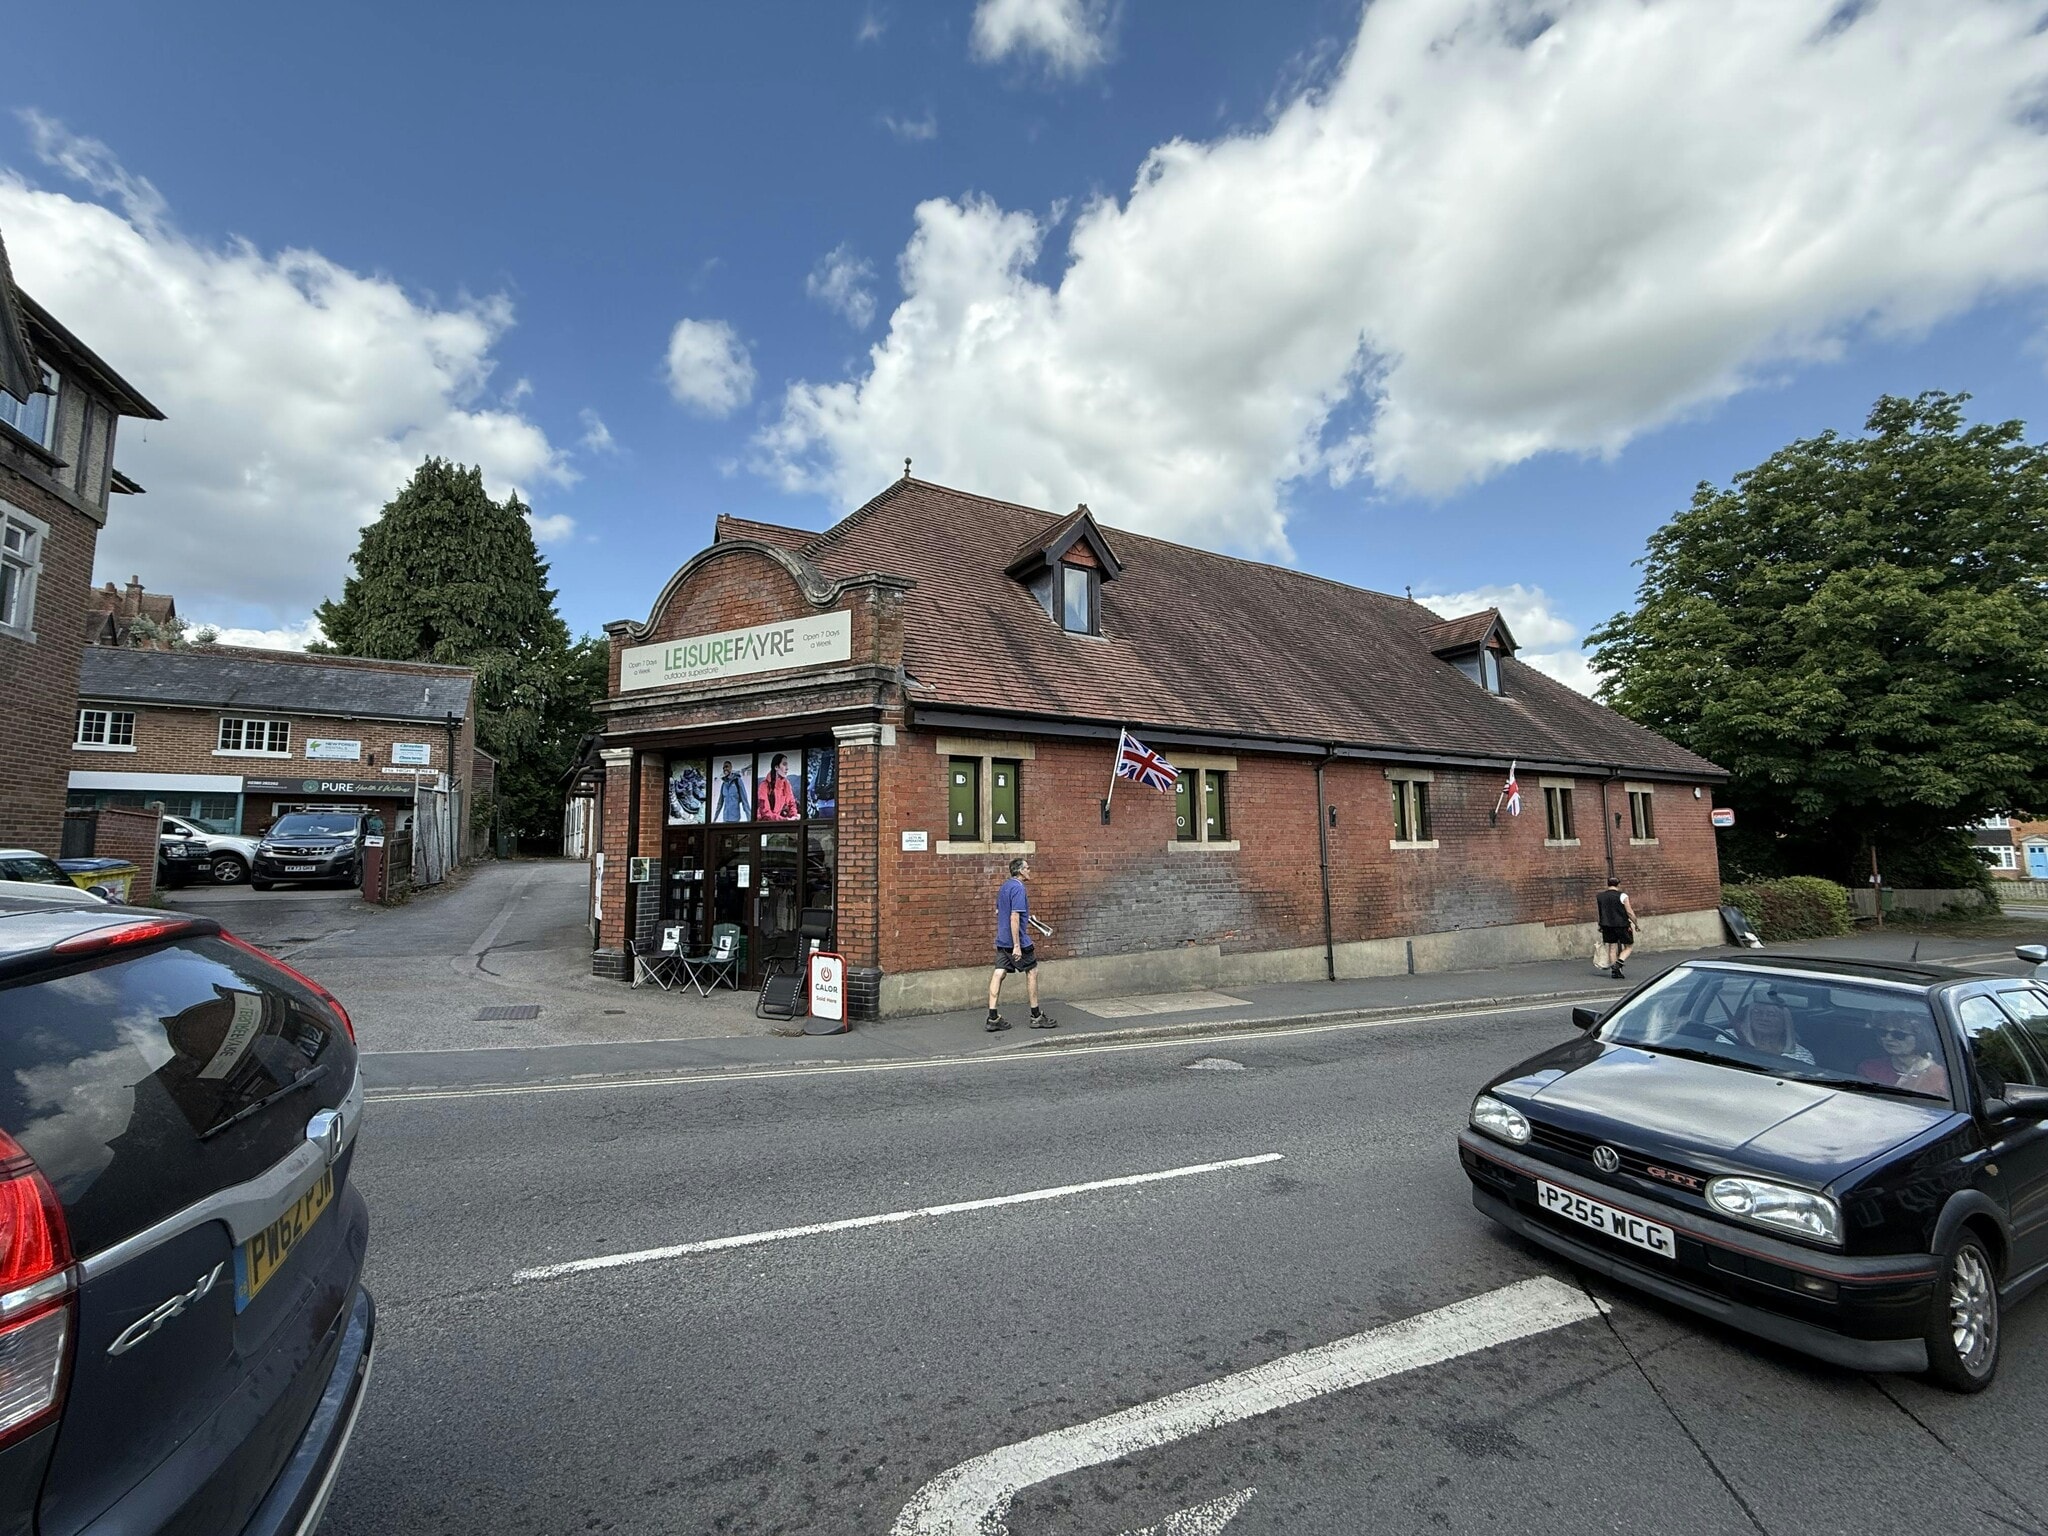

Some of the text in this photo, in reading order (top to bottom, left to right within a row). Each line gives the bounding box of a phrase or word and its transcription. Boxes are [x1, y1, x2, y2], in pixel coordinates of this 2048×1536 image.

[803, 633, 820, 642] Open
[825, 629, 840, 639] Days
[664, 628, 795, 672] LEISUREFAYRE
[816, 640, 832, 648] Week
[629, 661, 642, 669] Open
[646, 659, 657, 667] Days
[664, 666, 719, 681] outdoor superstore
[321, 782, 354, 792] PURE
[815, 983, 838, 994] CALOR
[1647, 1166, 1698, 1188] GTI
[1546, 1186, 1664, 1251] P255 WCG
